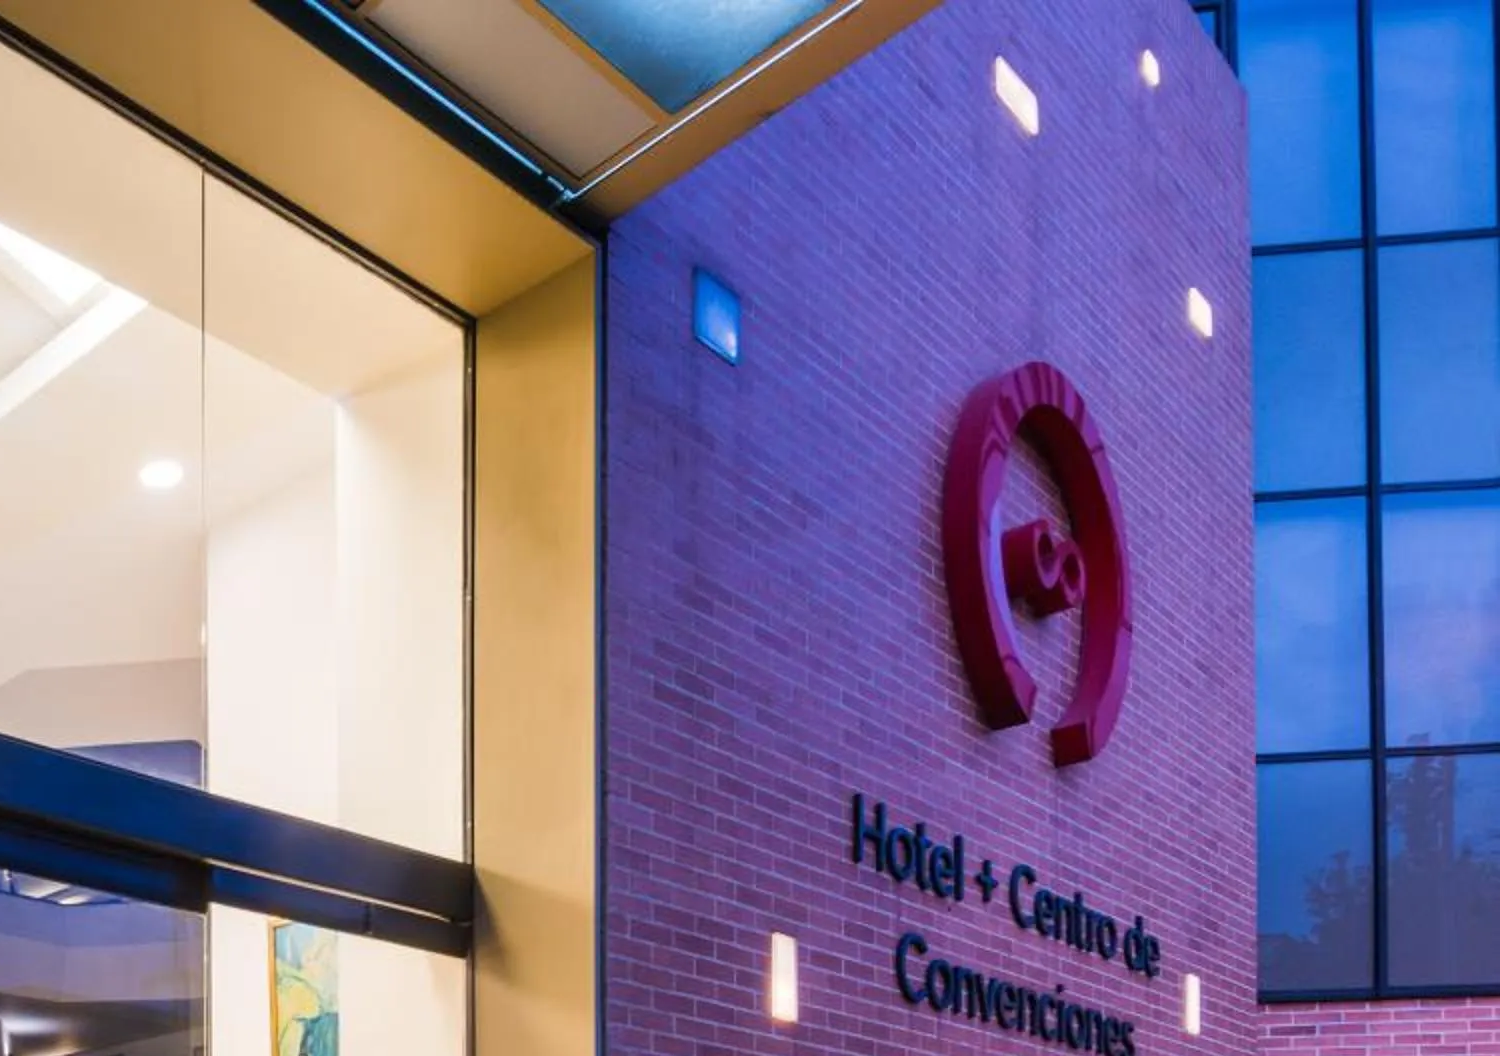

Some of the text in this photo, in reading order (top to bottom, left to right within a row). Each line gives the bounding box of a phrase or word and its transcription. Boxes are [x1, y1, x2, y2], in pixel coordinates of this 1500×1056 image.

[852, 793, 1161, 977] Hotel + Centro de
